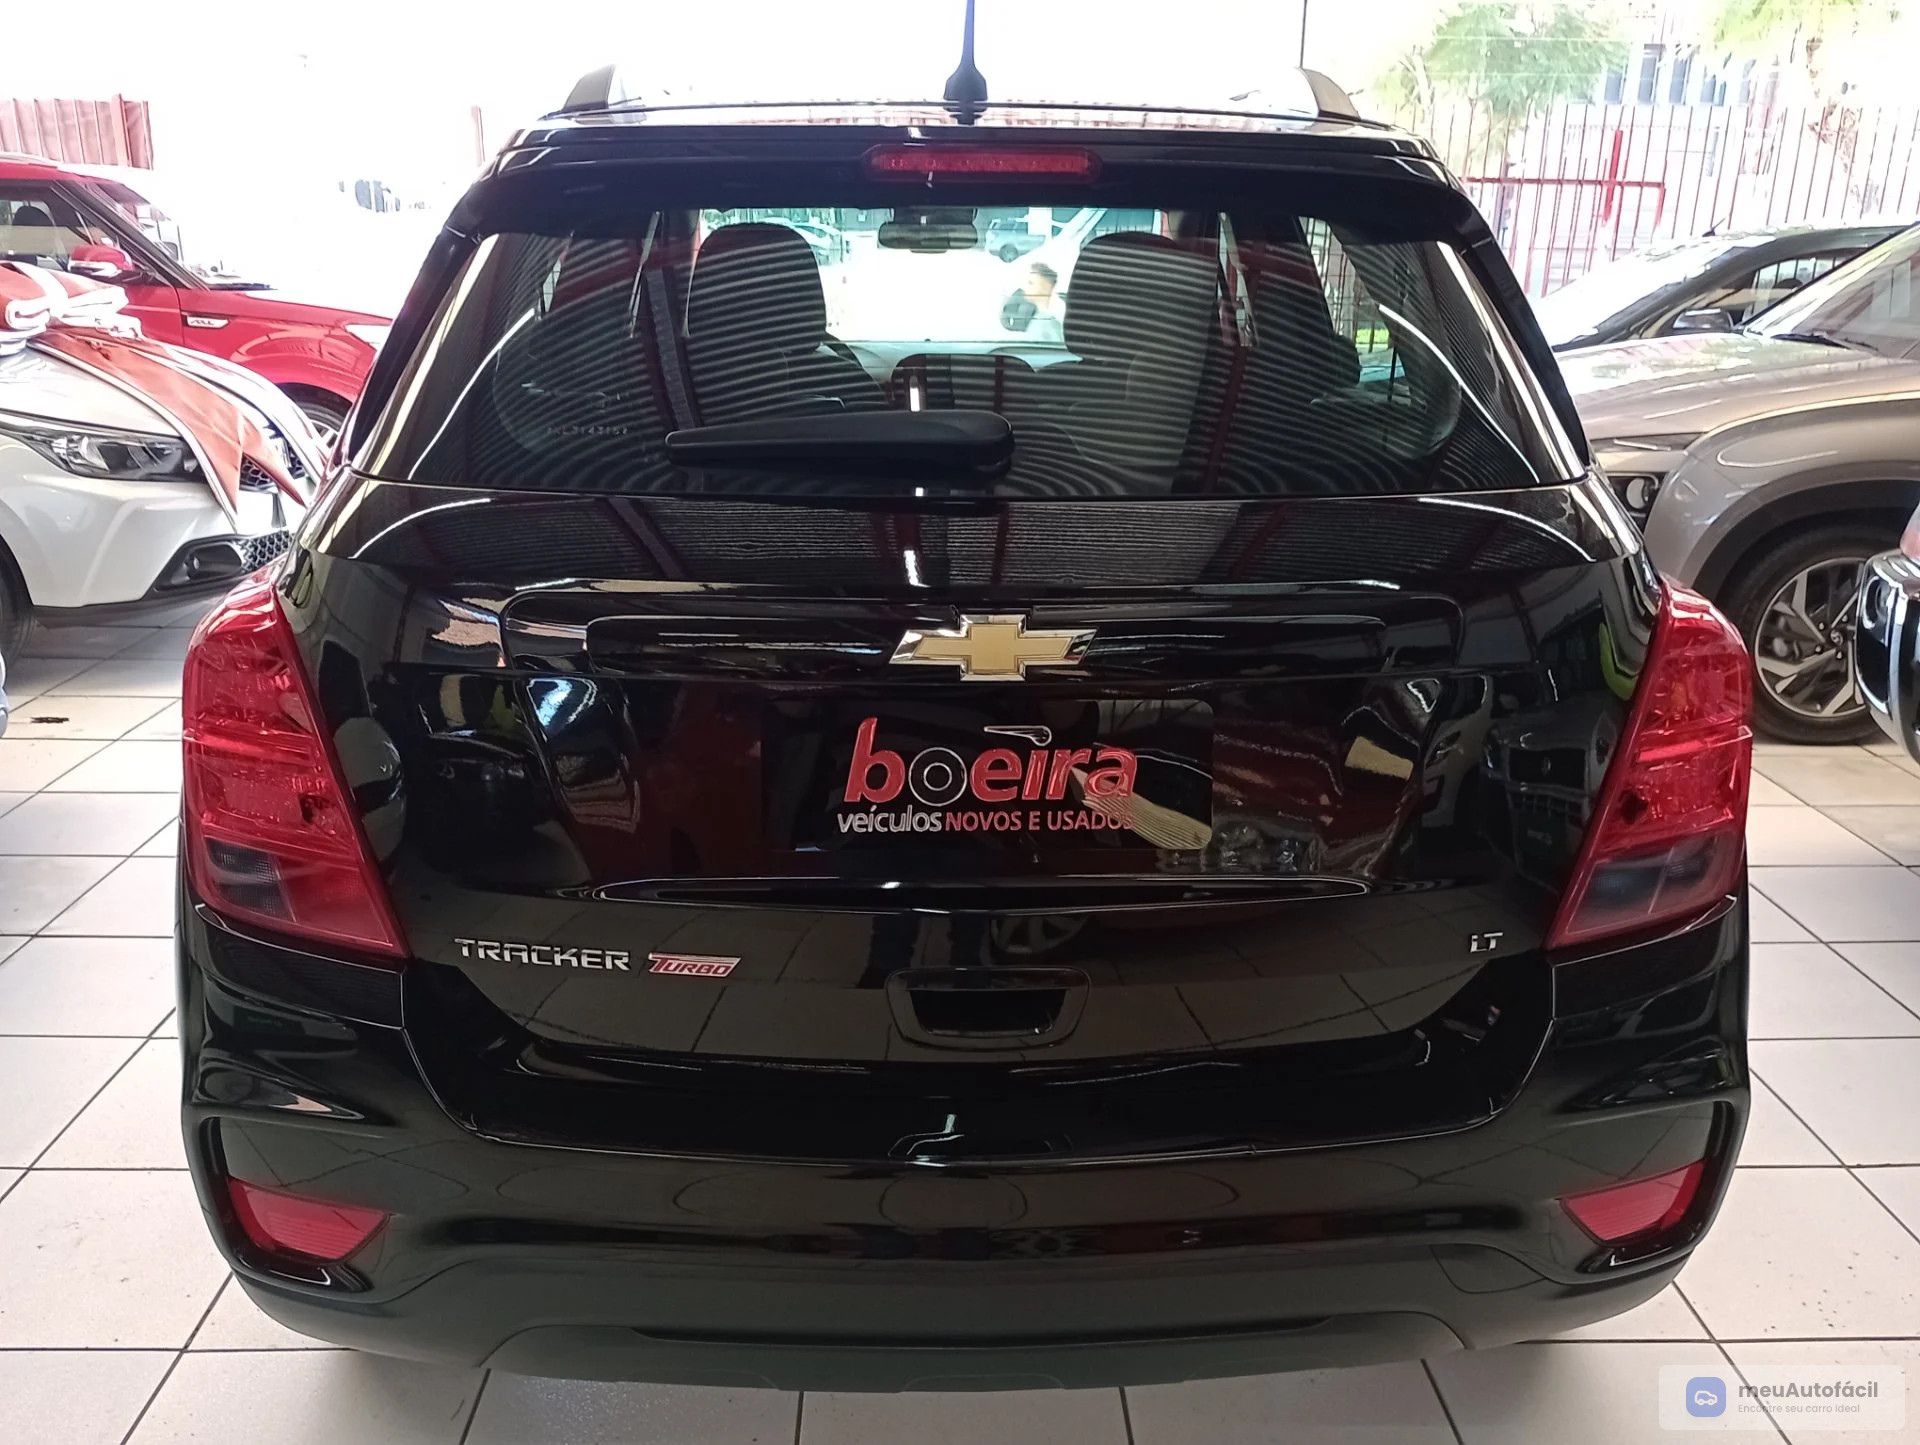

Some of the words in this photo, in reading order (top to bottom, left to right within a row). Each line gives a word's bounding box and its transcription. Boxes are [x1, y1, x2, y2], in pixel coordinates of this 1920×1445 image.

[844, 716, 1138, 807] boeira
[837, 805, 943, 833] veículos
[945, 810, 1022, 832] NOVOS
[1029, 811, 1040, 831] E
[1047, 810, 1135, 831] USADOS
[454, 937, 631, 972] TRACKER
[1470, 932, 1504, 953] LT
[650, 956, 734, 976] TURBO
